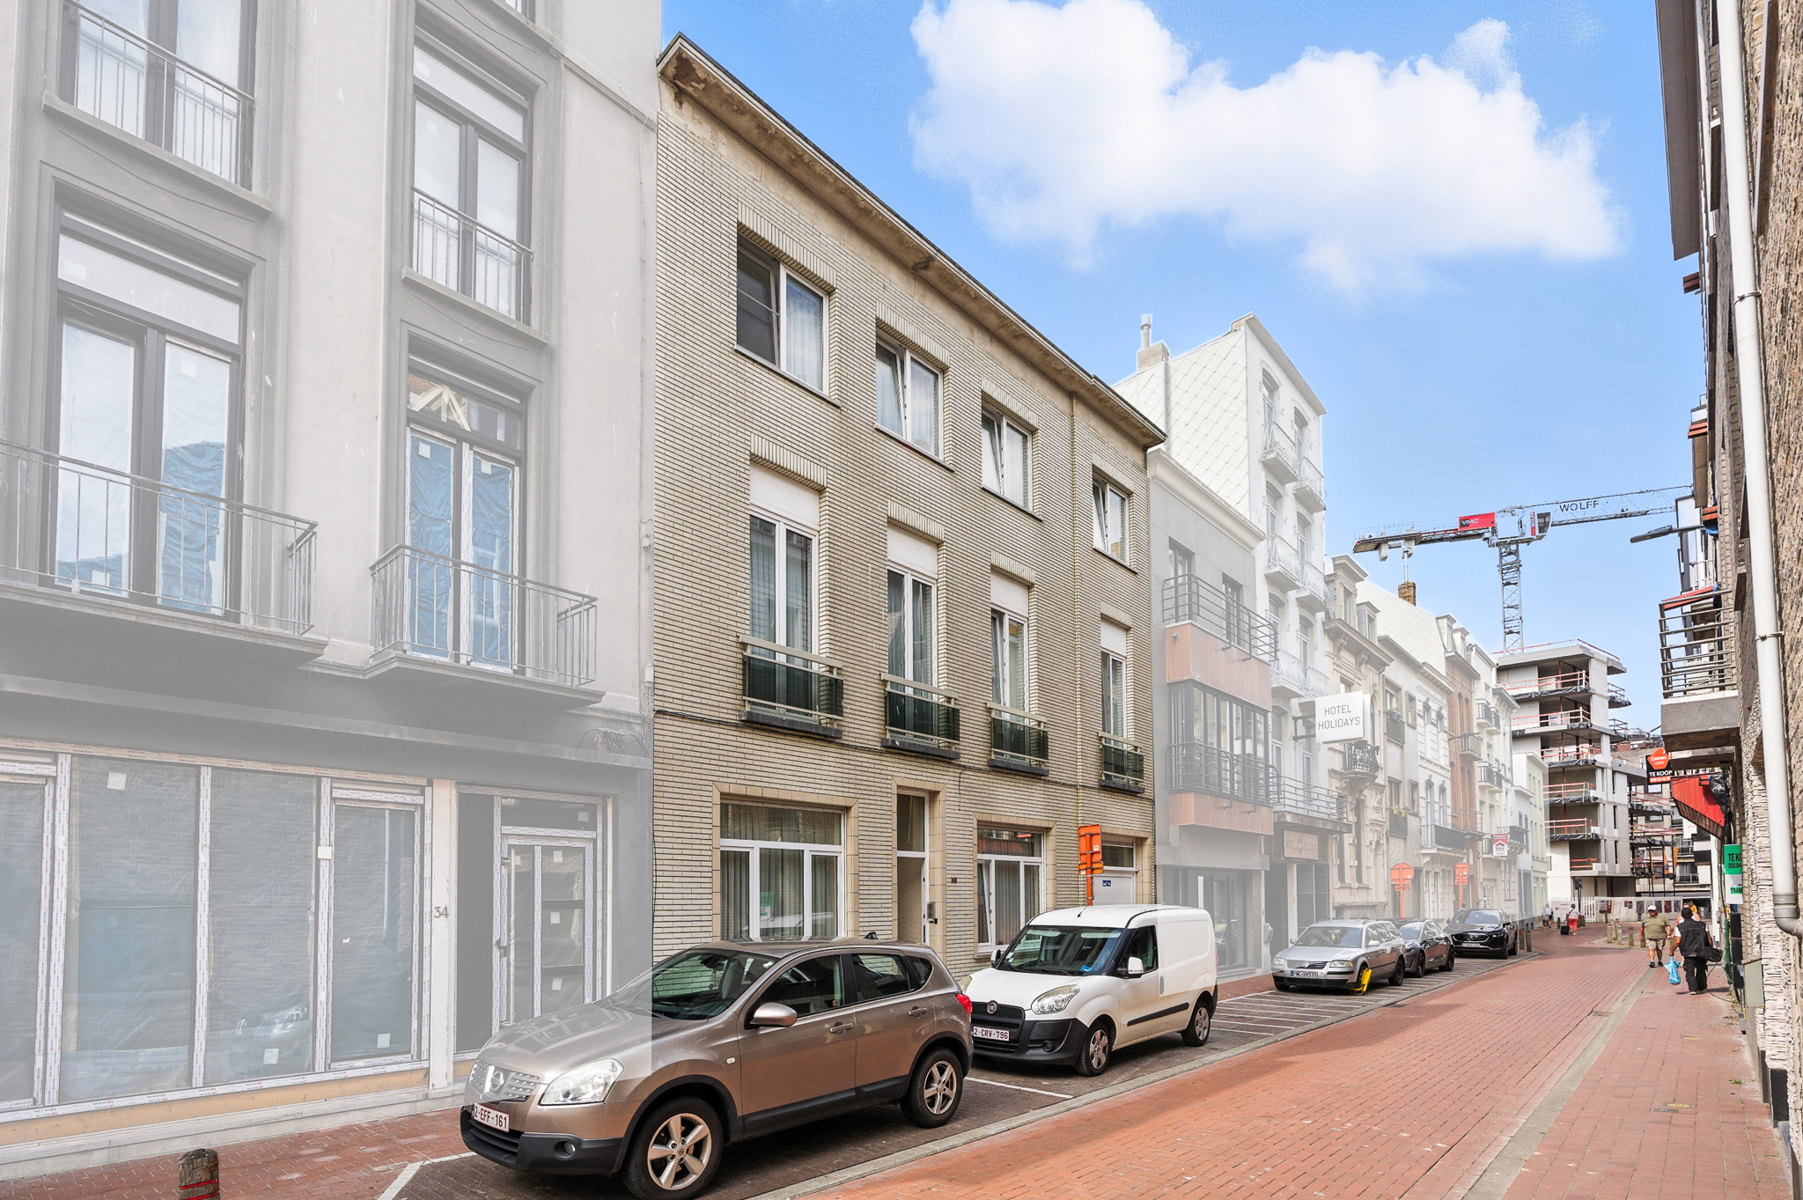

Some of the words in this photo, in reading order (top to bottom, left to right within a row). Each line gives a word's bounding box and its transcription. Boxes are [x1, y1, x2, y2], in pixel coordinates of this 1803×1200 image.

[1560, 500, 1599, 512] WOLFF
[1324, 704, 1352, 716] HOTEL
[1318, 716, 1361, 729] HOLIDAYS
[1728, 853, 1735, 862] TE
[434, 906, 449, 919] 34
[974, 1028, 1009, 1039] 2-CRV-796
[474, 1105, 507, 1129] 2-EFF-161
